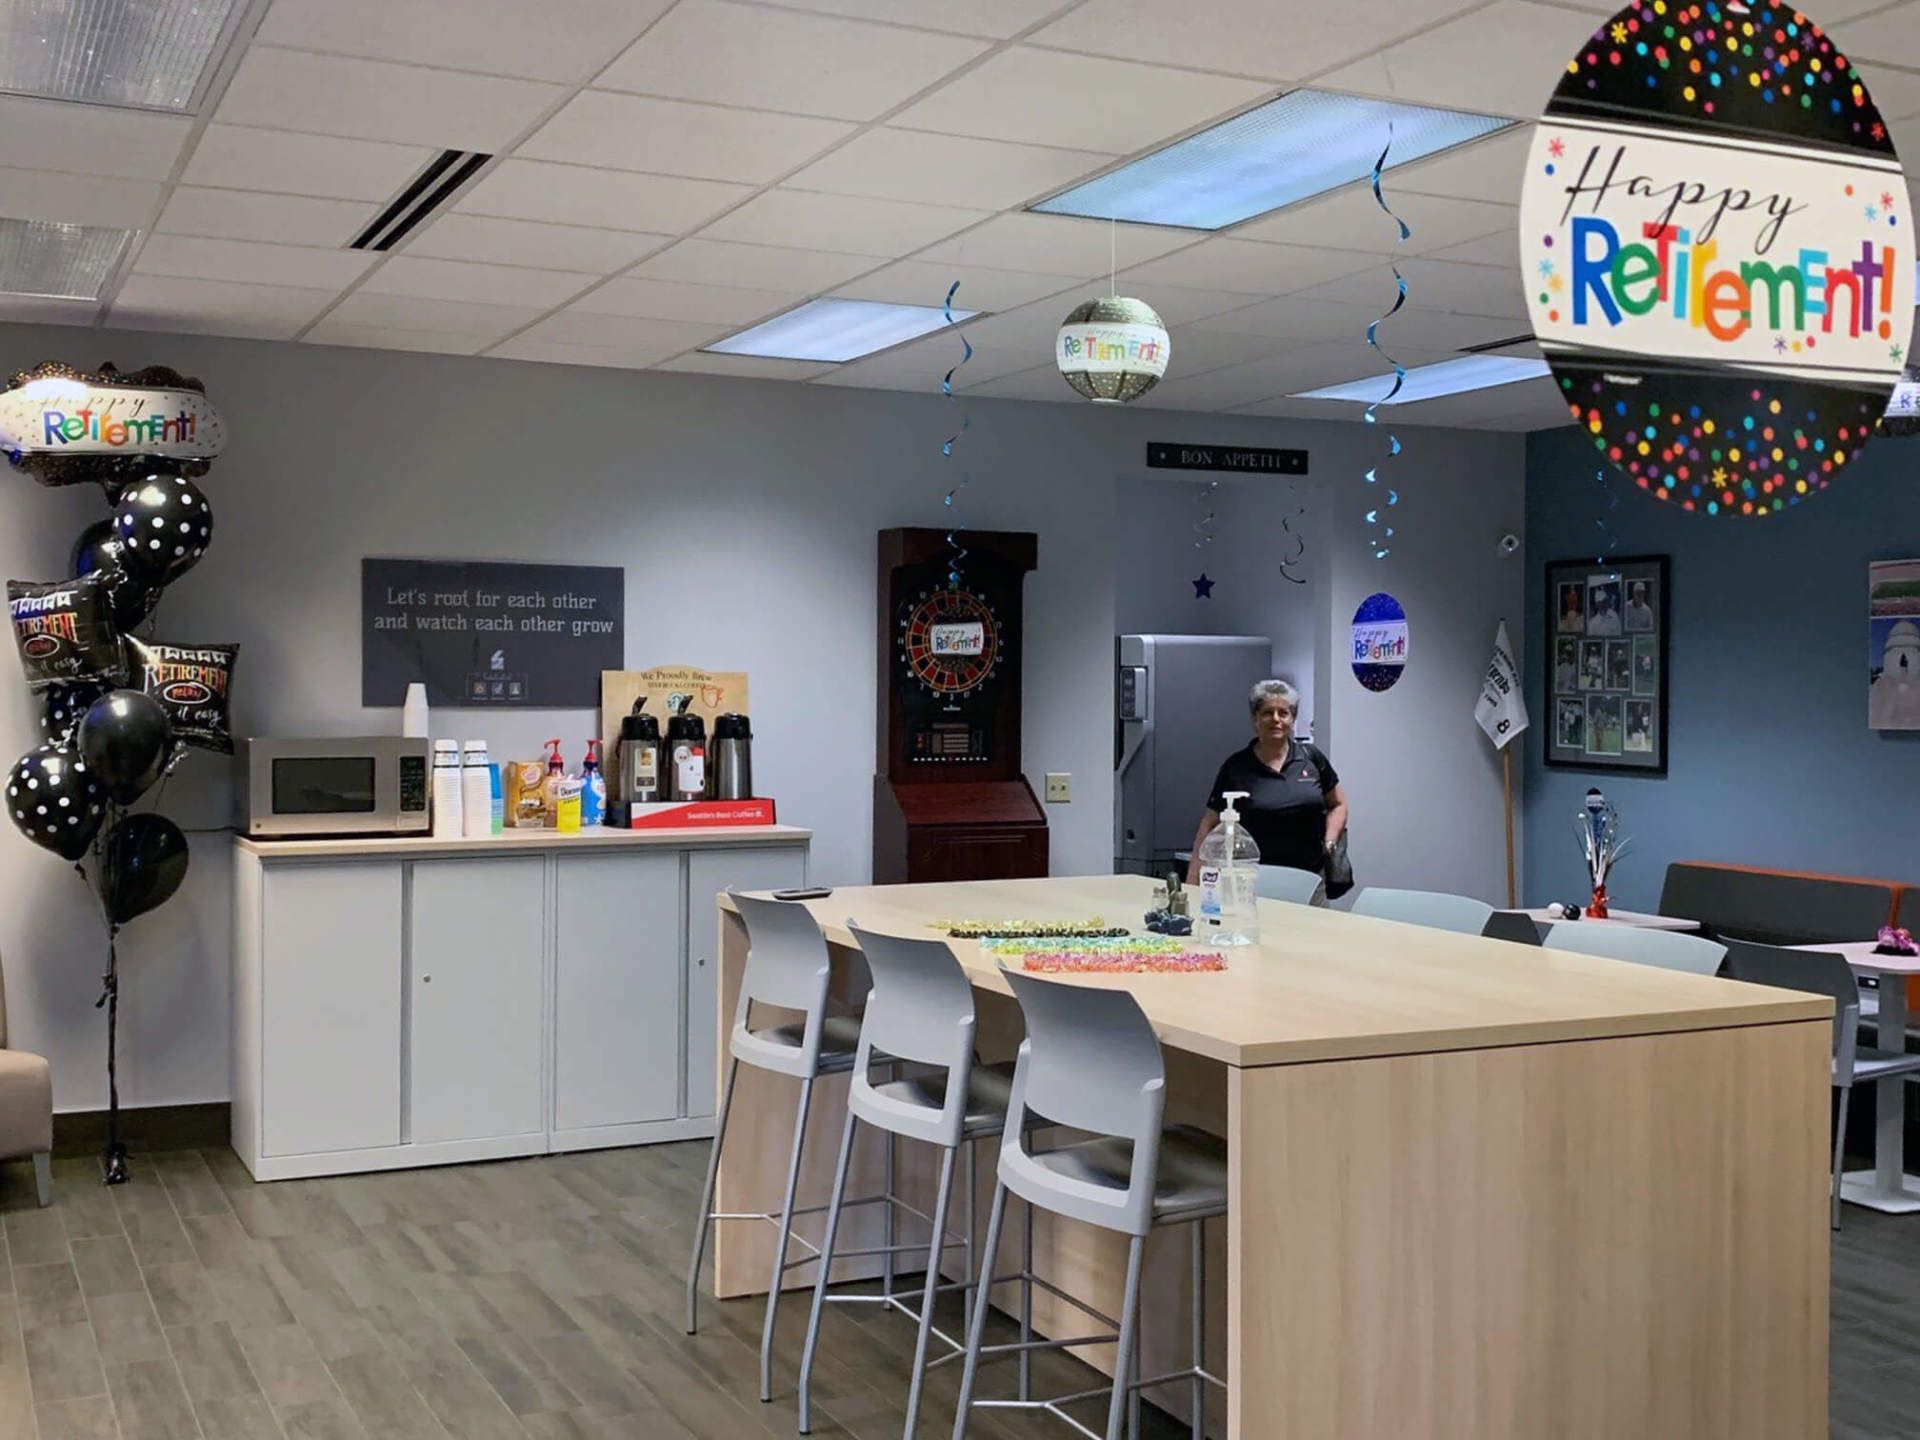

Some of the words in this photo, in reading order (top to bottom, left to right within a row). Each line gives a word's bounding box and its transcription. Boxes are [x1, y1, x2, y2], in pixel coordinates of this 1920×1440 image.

[1561, 146, 1808, 254] Happy
[1182, 450, 1213, 464] BON
[1223, 452, 1280, 469] APPETIT
[387, 586, 427, 605] Let's
[434, 590, 470, 607] root
[476, 590, 500, 607] for
[508, 591, 546, 608] each
[552, 592, 597, 609] other
[374, 612, 408, 629] and
[416, 613, 467, 630] watch
[475, 614, 514, 631] each
[521, 615, 565, 631] other
[572, 620, 614, 636] grow
[1496, 718, 1510, 734] 8
